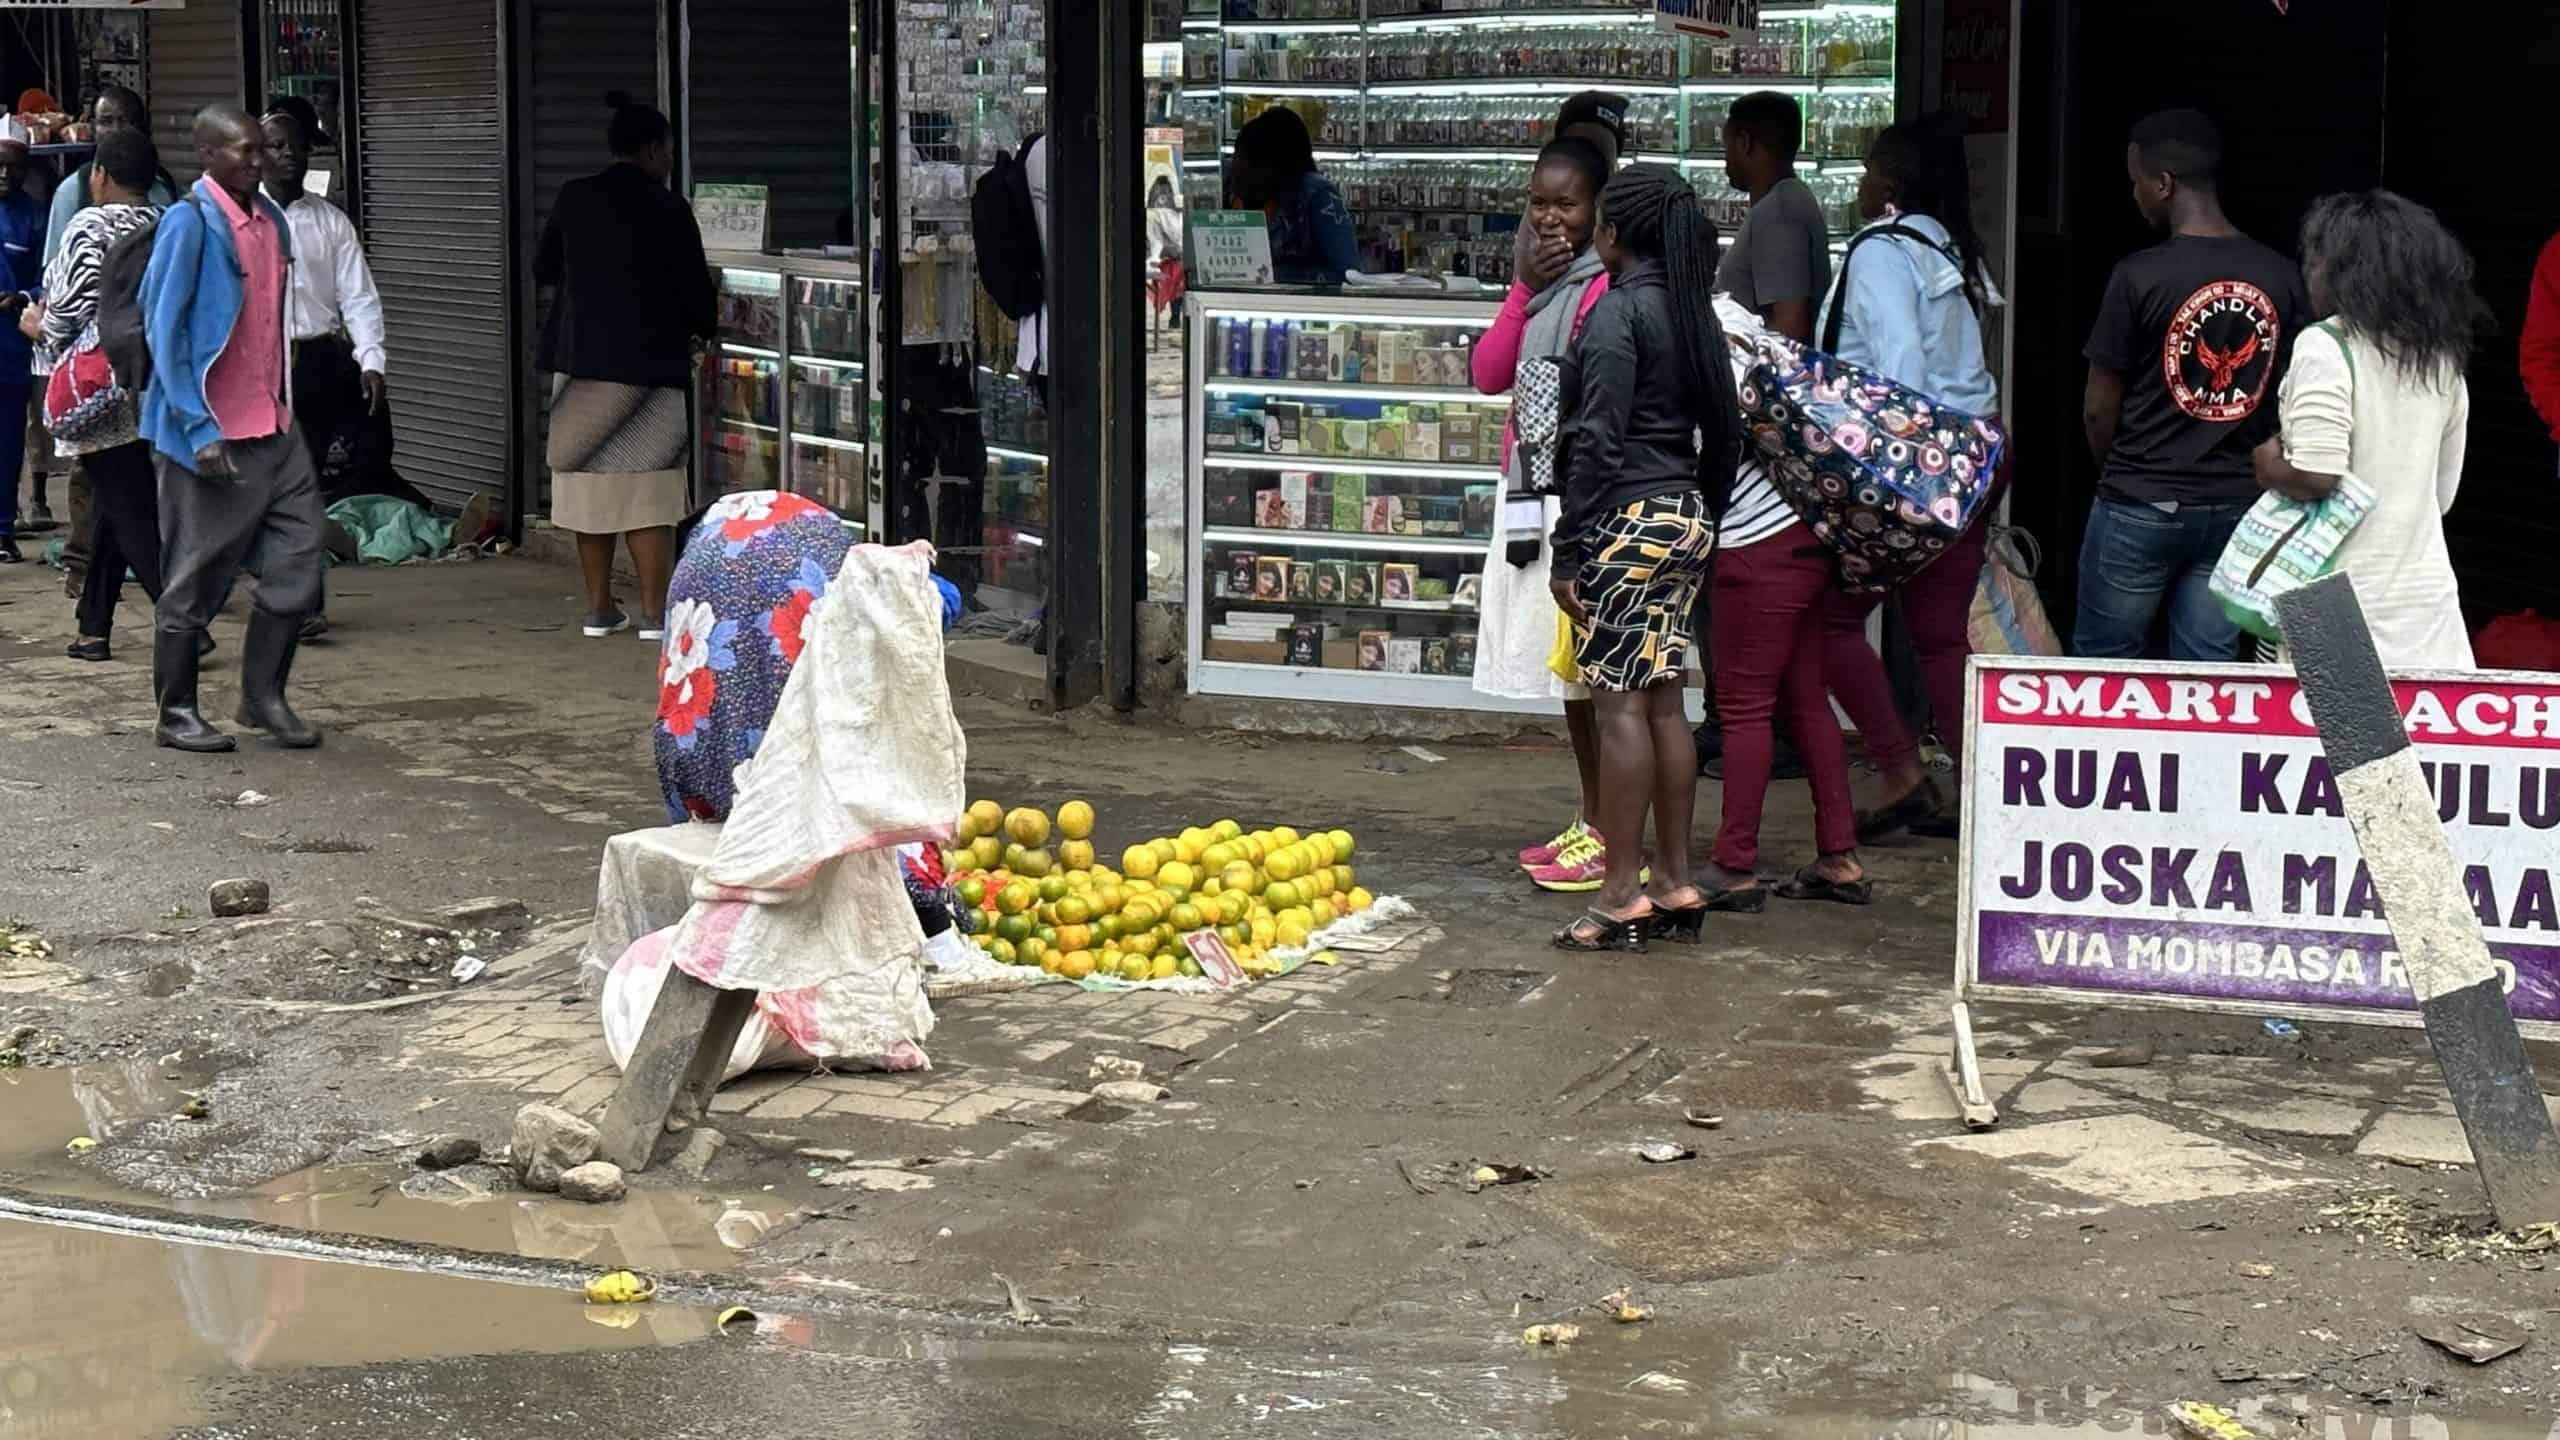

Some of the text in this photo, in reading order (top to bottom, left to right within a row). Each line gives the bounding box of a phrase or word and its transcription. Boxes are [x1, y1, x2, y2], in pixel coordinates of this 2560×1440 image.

[2180, 298, 2273, 355] CHANDLER
[2194, 387, 2247, 405] MMA
[1997, 672, 2560, 740] SMART ACH
[2002, 746, 2560, 830] RUAI KAULU
[1999, 839, 2560, 931] JOSKA MAAA
[2034, 928, 2114, 969] VIA
[2126, 935, 2367, 983] MOMBASA
